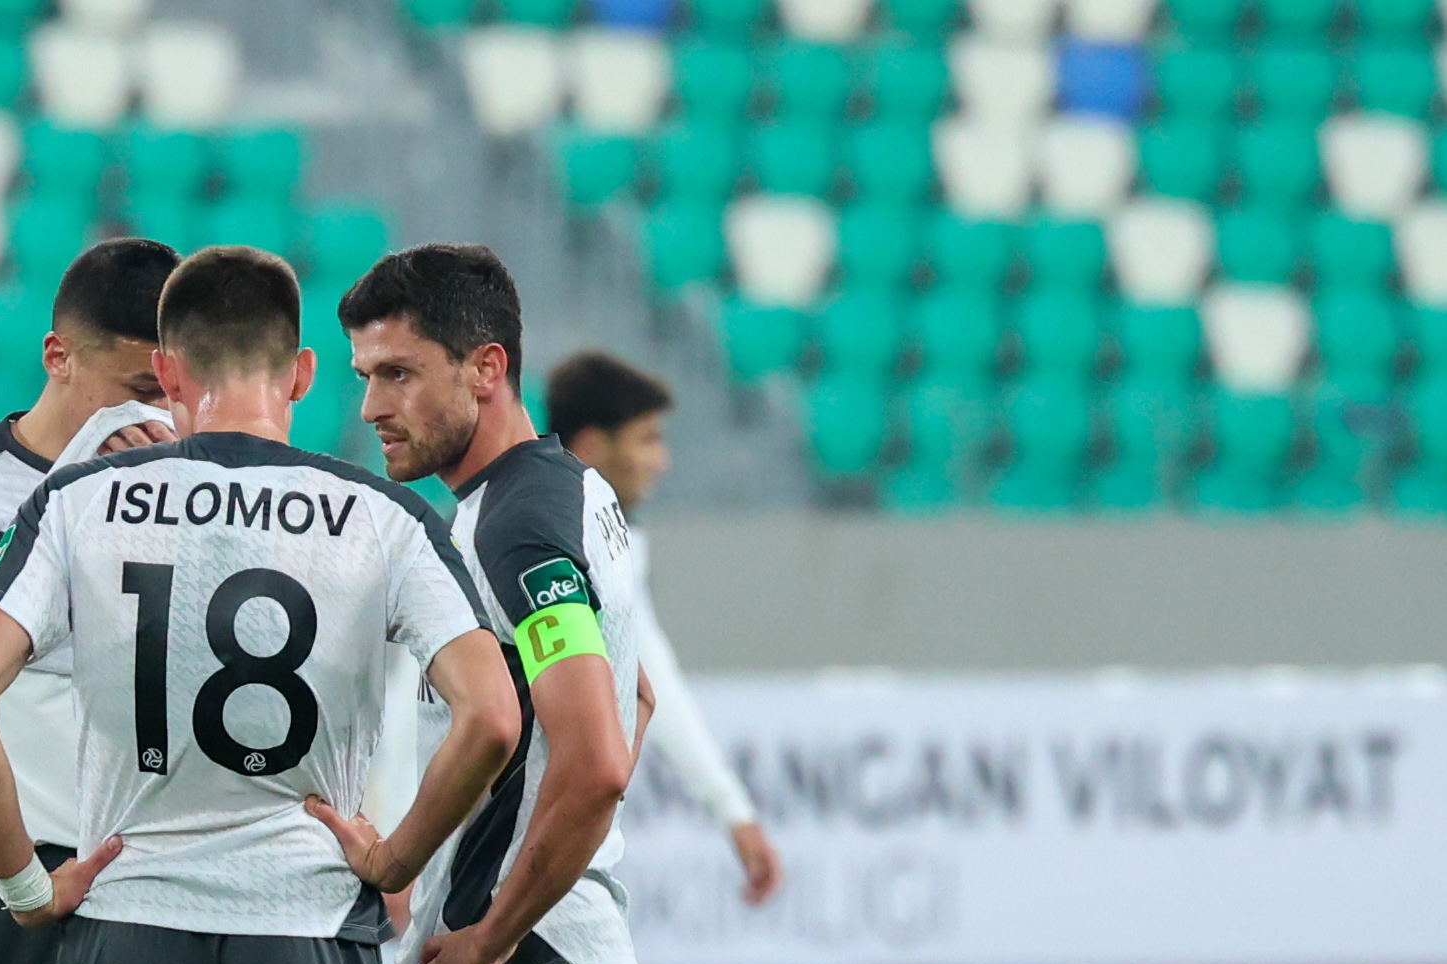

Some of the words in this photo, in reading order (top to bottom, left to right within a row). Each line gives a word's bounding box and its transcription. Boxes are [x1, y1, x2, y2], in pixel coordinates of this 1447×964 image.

[106, 481, 357, 537] ISLOMOV
[537, 574, 580, 605] artel
[528, 615, 566, 663] C
[121, 561, 319, 777] 18
[1049, 728, 1402, 830] VILOYAT
